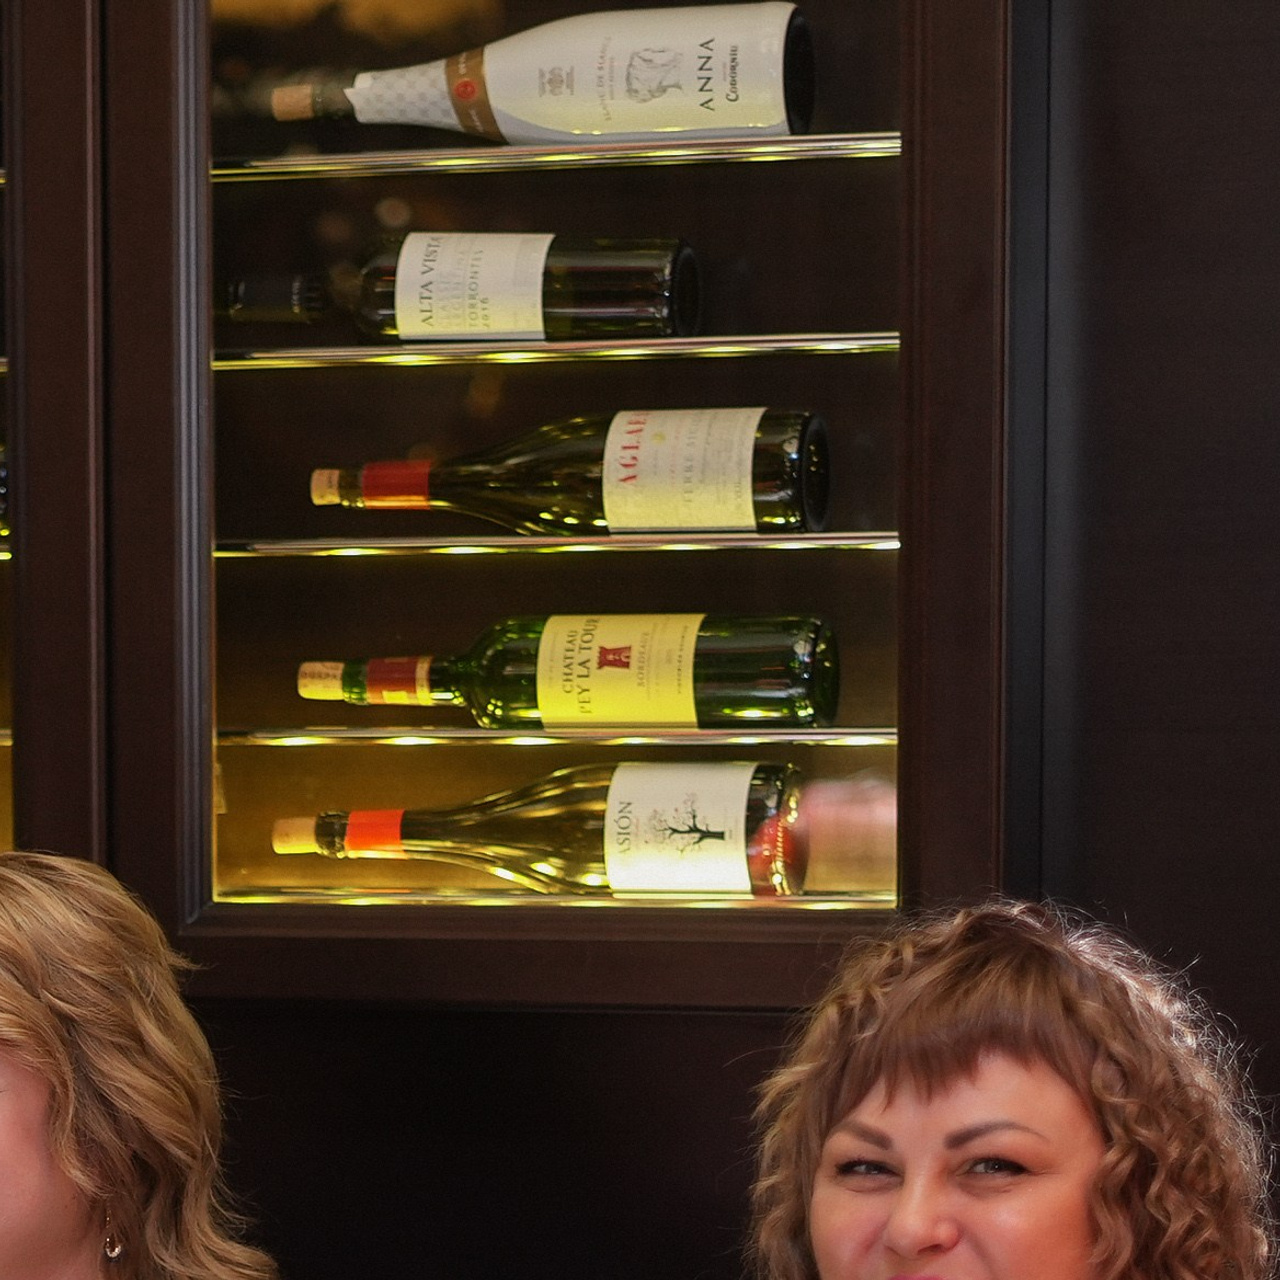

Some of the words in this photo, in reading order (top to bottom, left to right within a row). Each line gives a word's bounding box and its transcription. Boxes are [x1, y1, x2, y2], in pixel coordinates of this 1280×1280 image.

[697, 38, 715, 112] ANNA
[419, 281, 434, 327] ALTA
[562, 630, 578, 694] CHATEAU
[576, 659, 591, 679] LA
[576, 685, 593, 714] PEY
